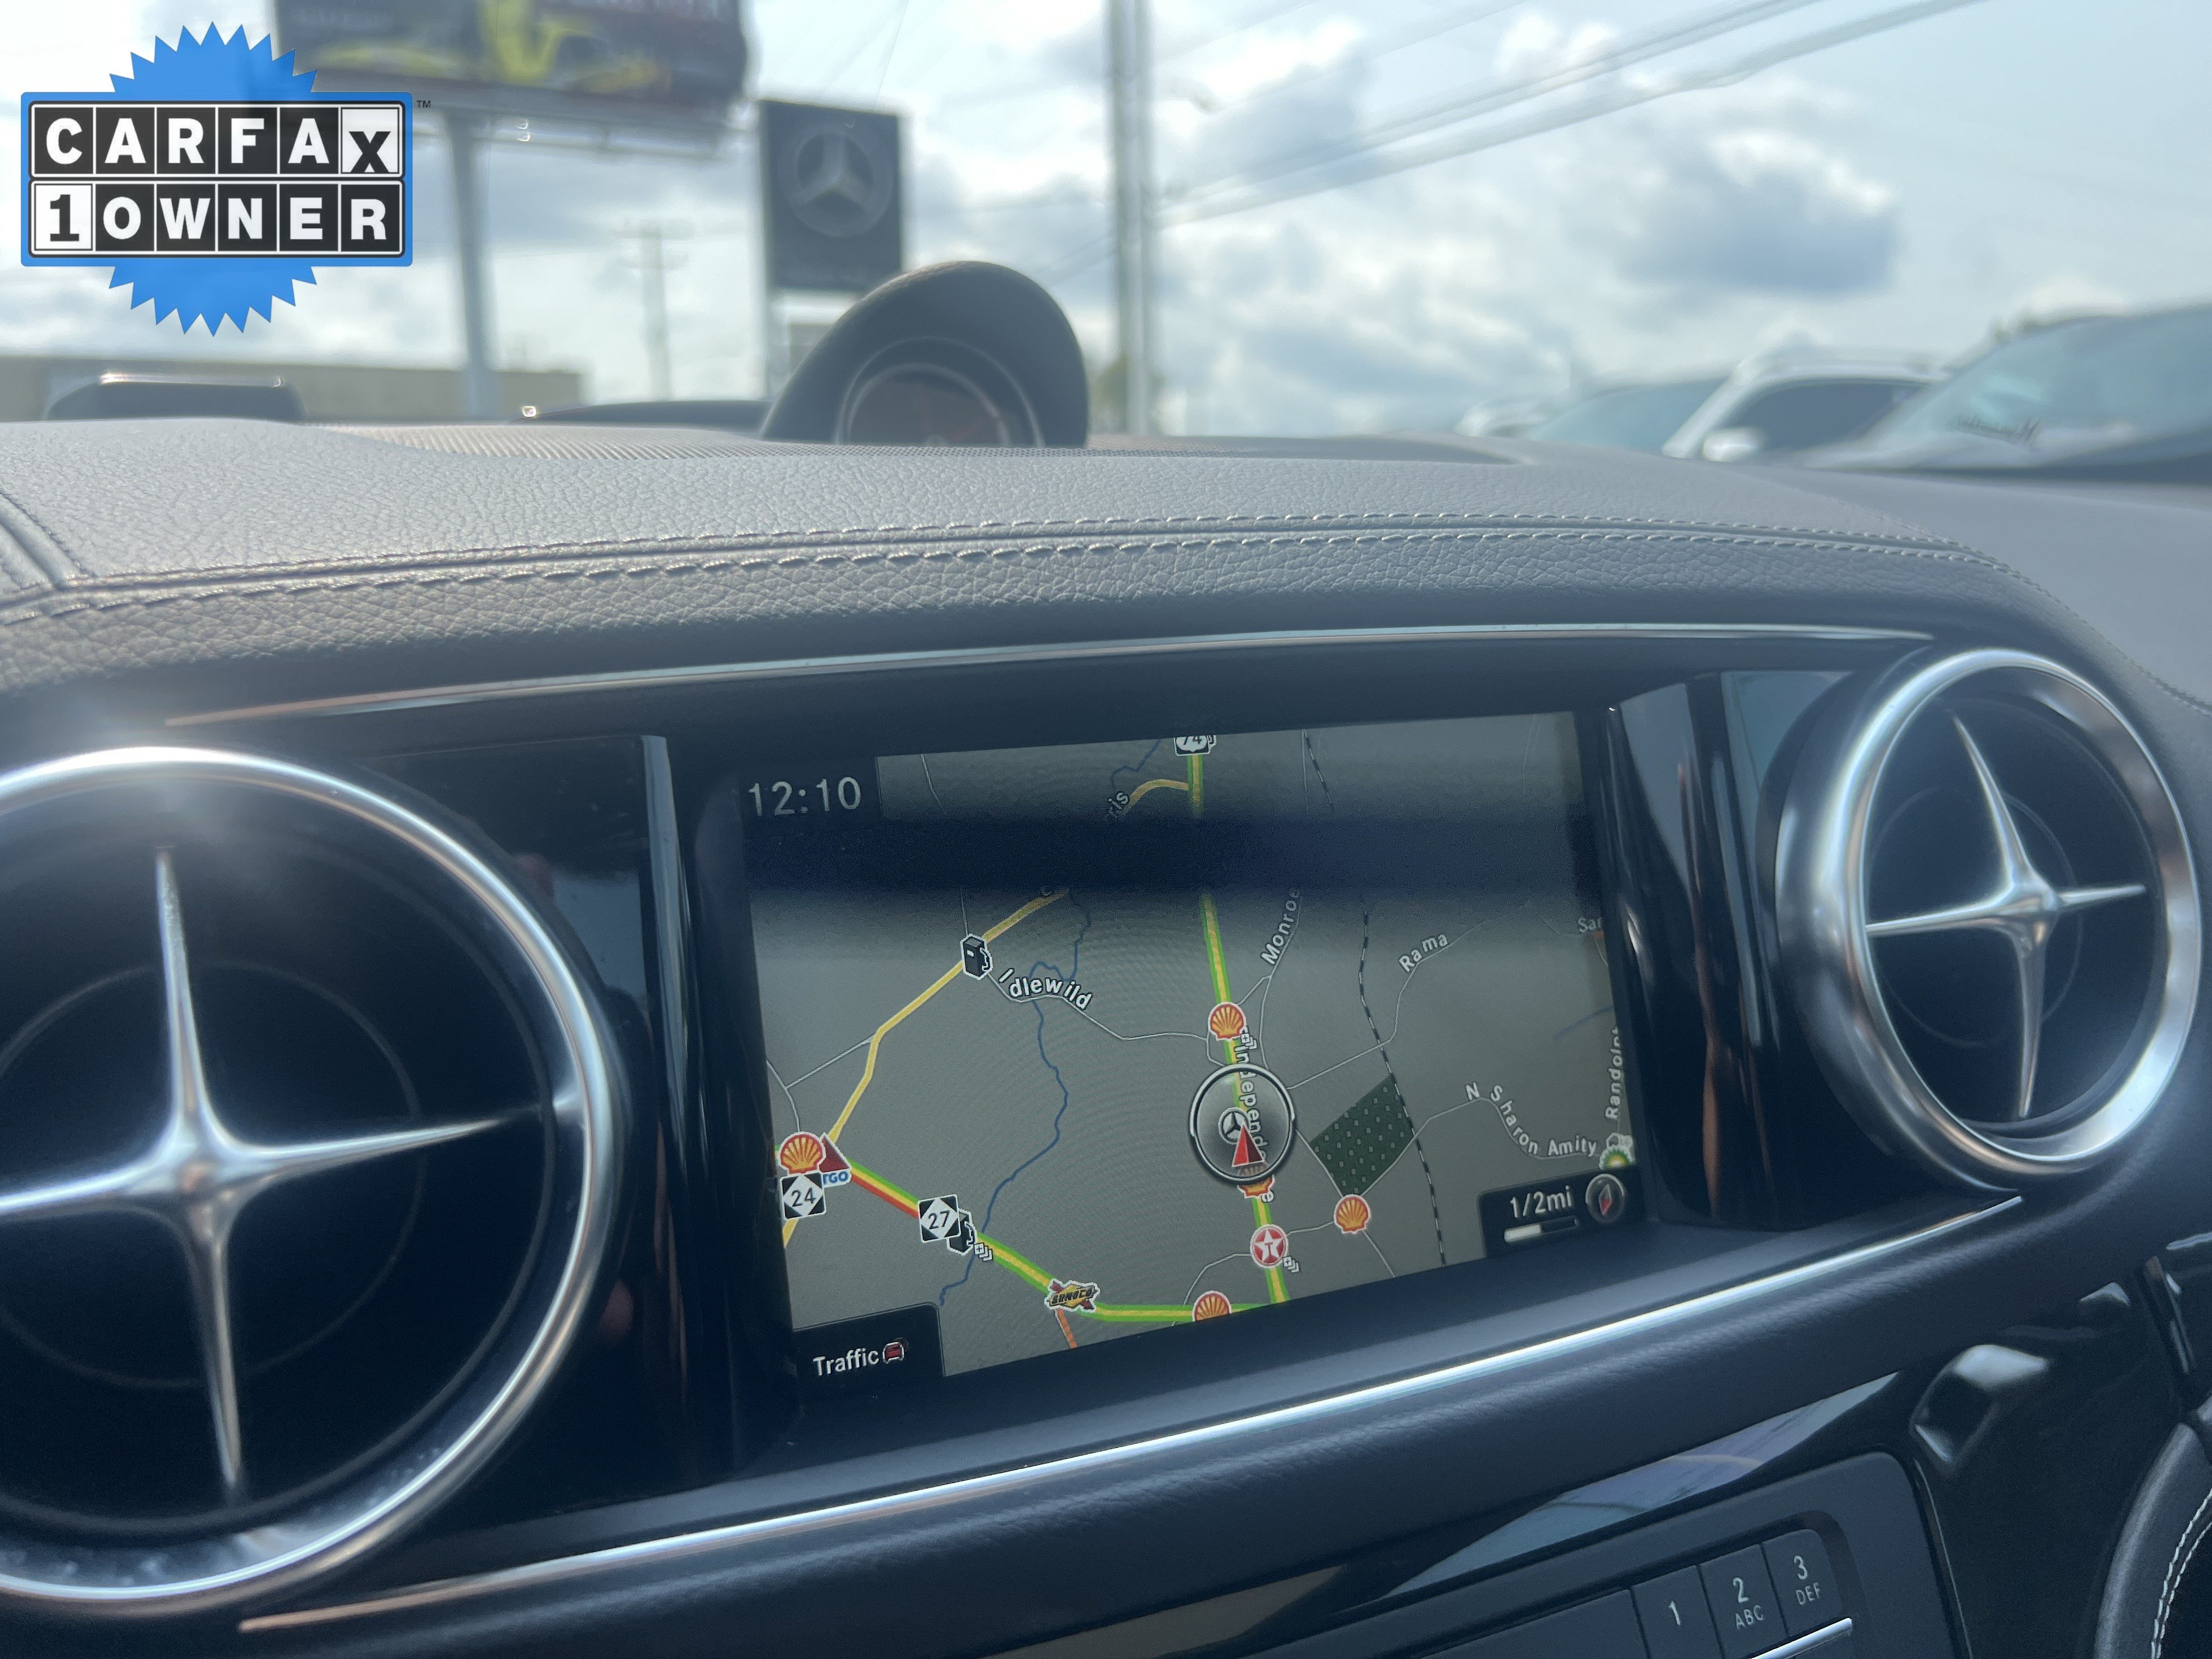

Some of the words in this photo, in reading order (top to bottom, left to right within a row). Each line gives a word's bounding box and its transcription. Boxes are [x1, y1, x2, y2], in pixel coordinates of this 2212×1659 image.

[748, 776, 861, 816] 12:10
[1398, 934, 1448, 973] Rama
[998, 968, 1092, 1009] Idlewild
[1466, 1082, 1480, 1101] N
[1489, 1085, 1538, 1155] Sharon
[1548, 1134, 1596, 1158] Amity
[791, 1187, 816, 1207] 24
[928, 1210, 950, 1229] 27
[812, 1347, 879, 1376] Traffic
[1793, 1555, 1808, 1580] 3
[1732, 1577, 1750, 1604] 2
[1795, 1582, 1821, 1605] DEF
[1668, 1600, 1681, 1626] 1
[1735, 1604, 1764, 1630] ABC
